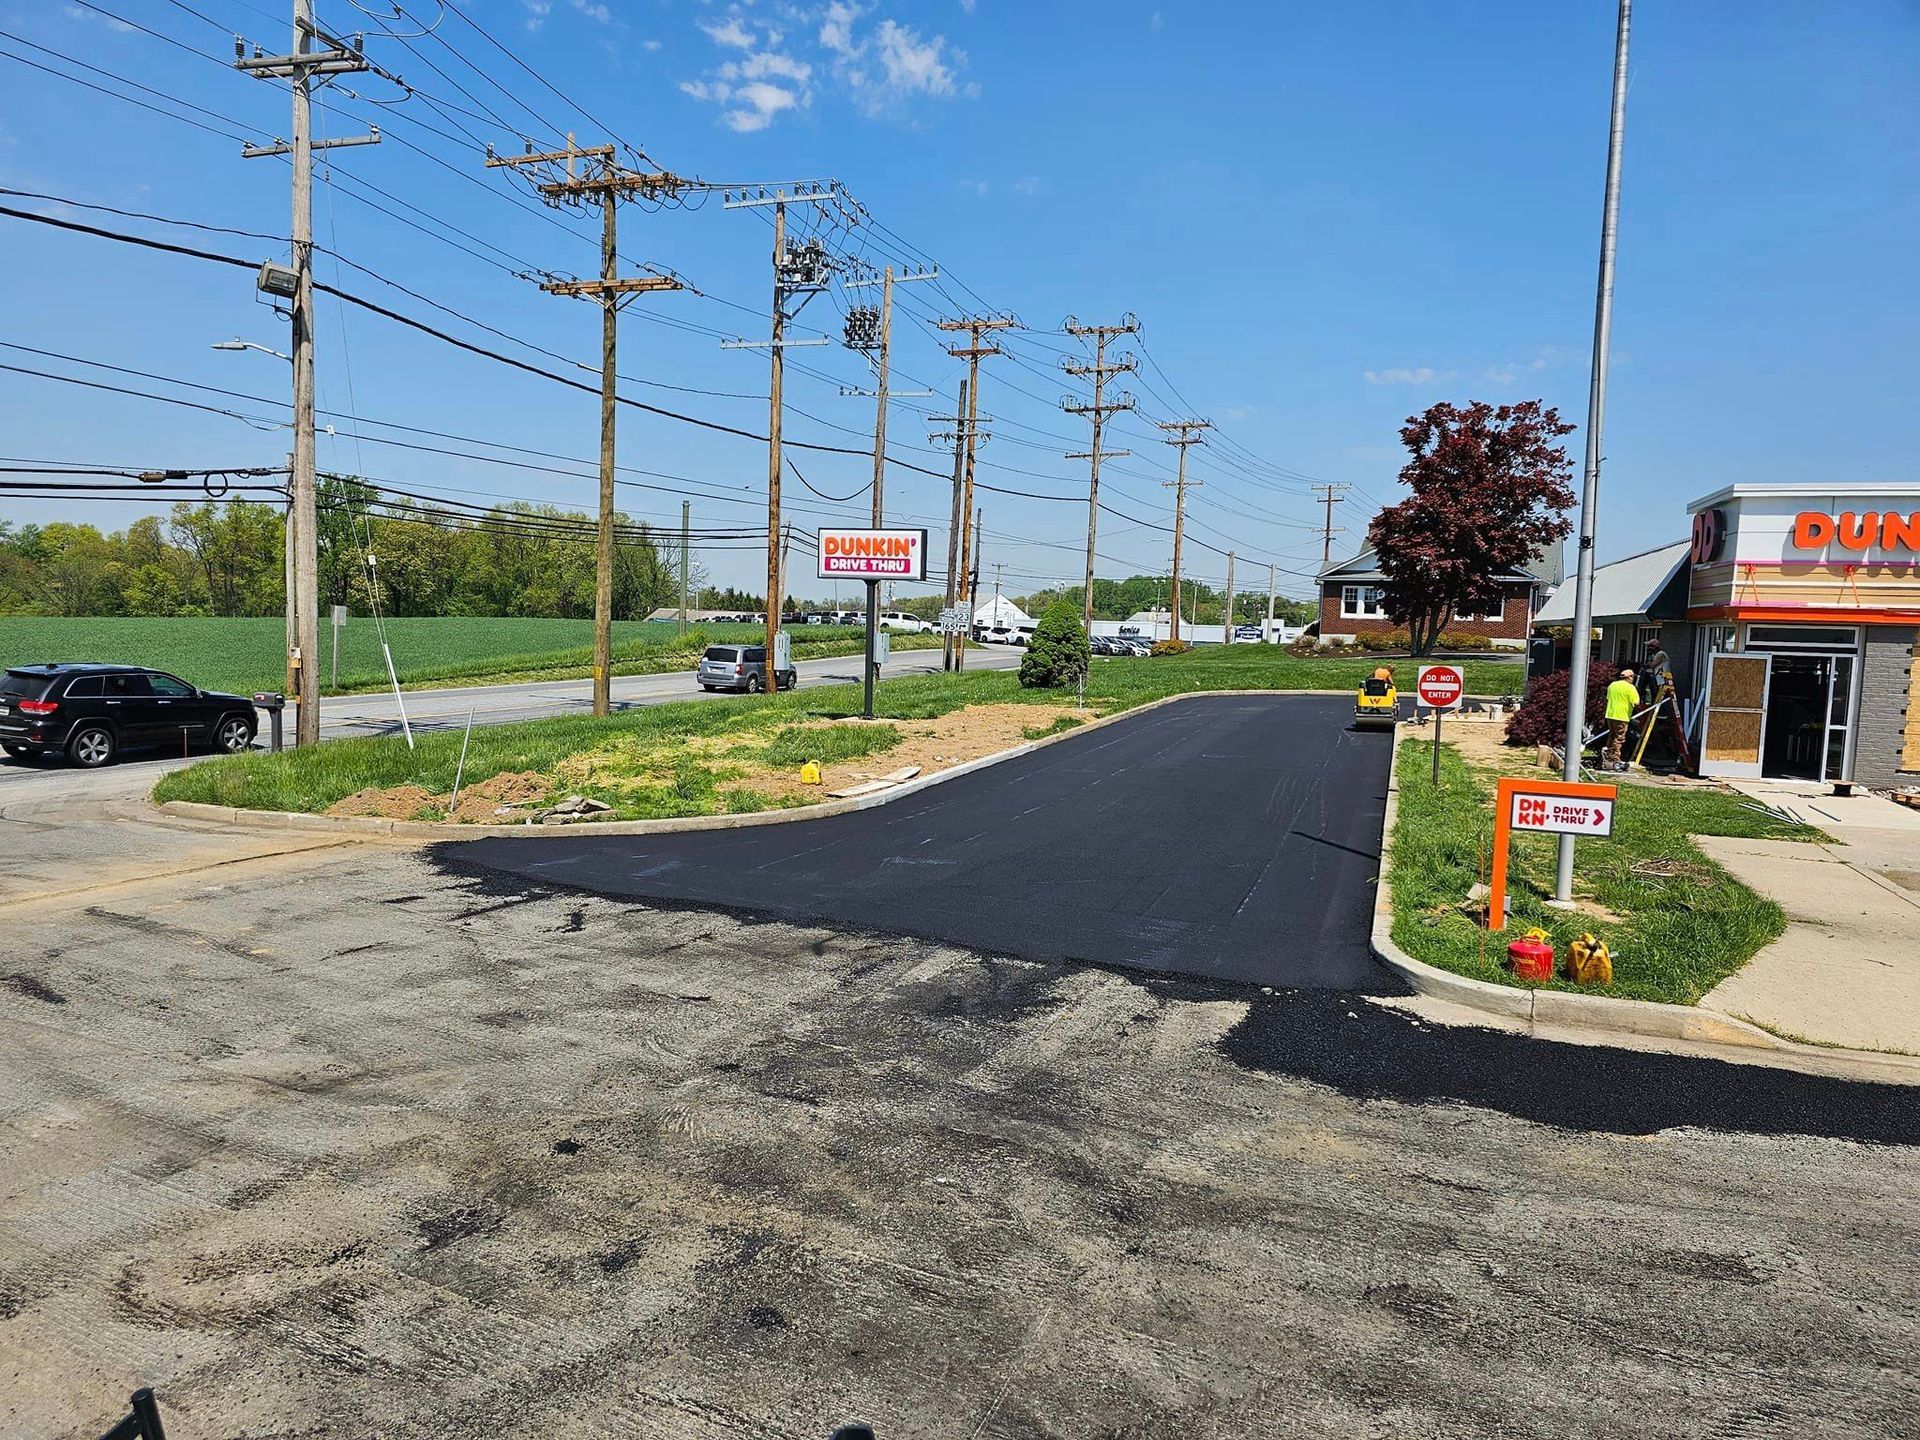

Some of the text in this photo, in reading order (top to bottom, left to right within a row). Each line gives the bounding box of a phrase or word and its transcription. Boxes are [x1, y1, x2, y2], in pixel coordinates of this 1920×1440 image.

[824, 536, 917, 557] DUNKIN'
[830, 558, 905, 572] DRIVE THRU
[958, 613, 970, 622] 23
[942, 622, 956, 631] 165
[1426, 674, 1456, 682] DO NOT
[1519, 799, 1546, 812] DN
[1553, 806, 1589, 816] DRIVE
[1518, 812, 1550, 826] KN'
[1553, 815, 1586, 825] THRU
